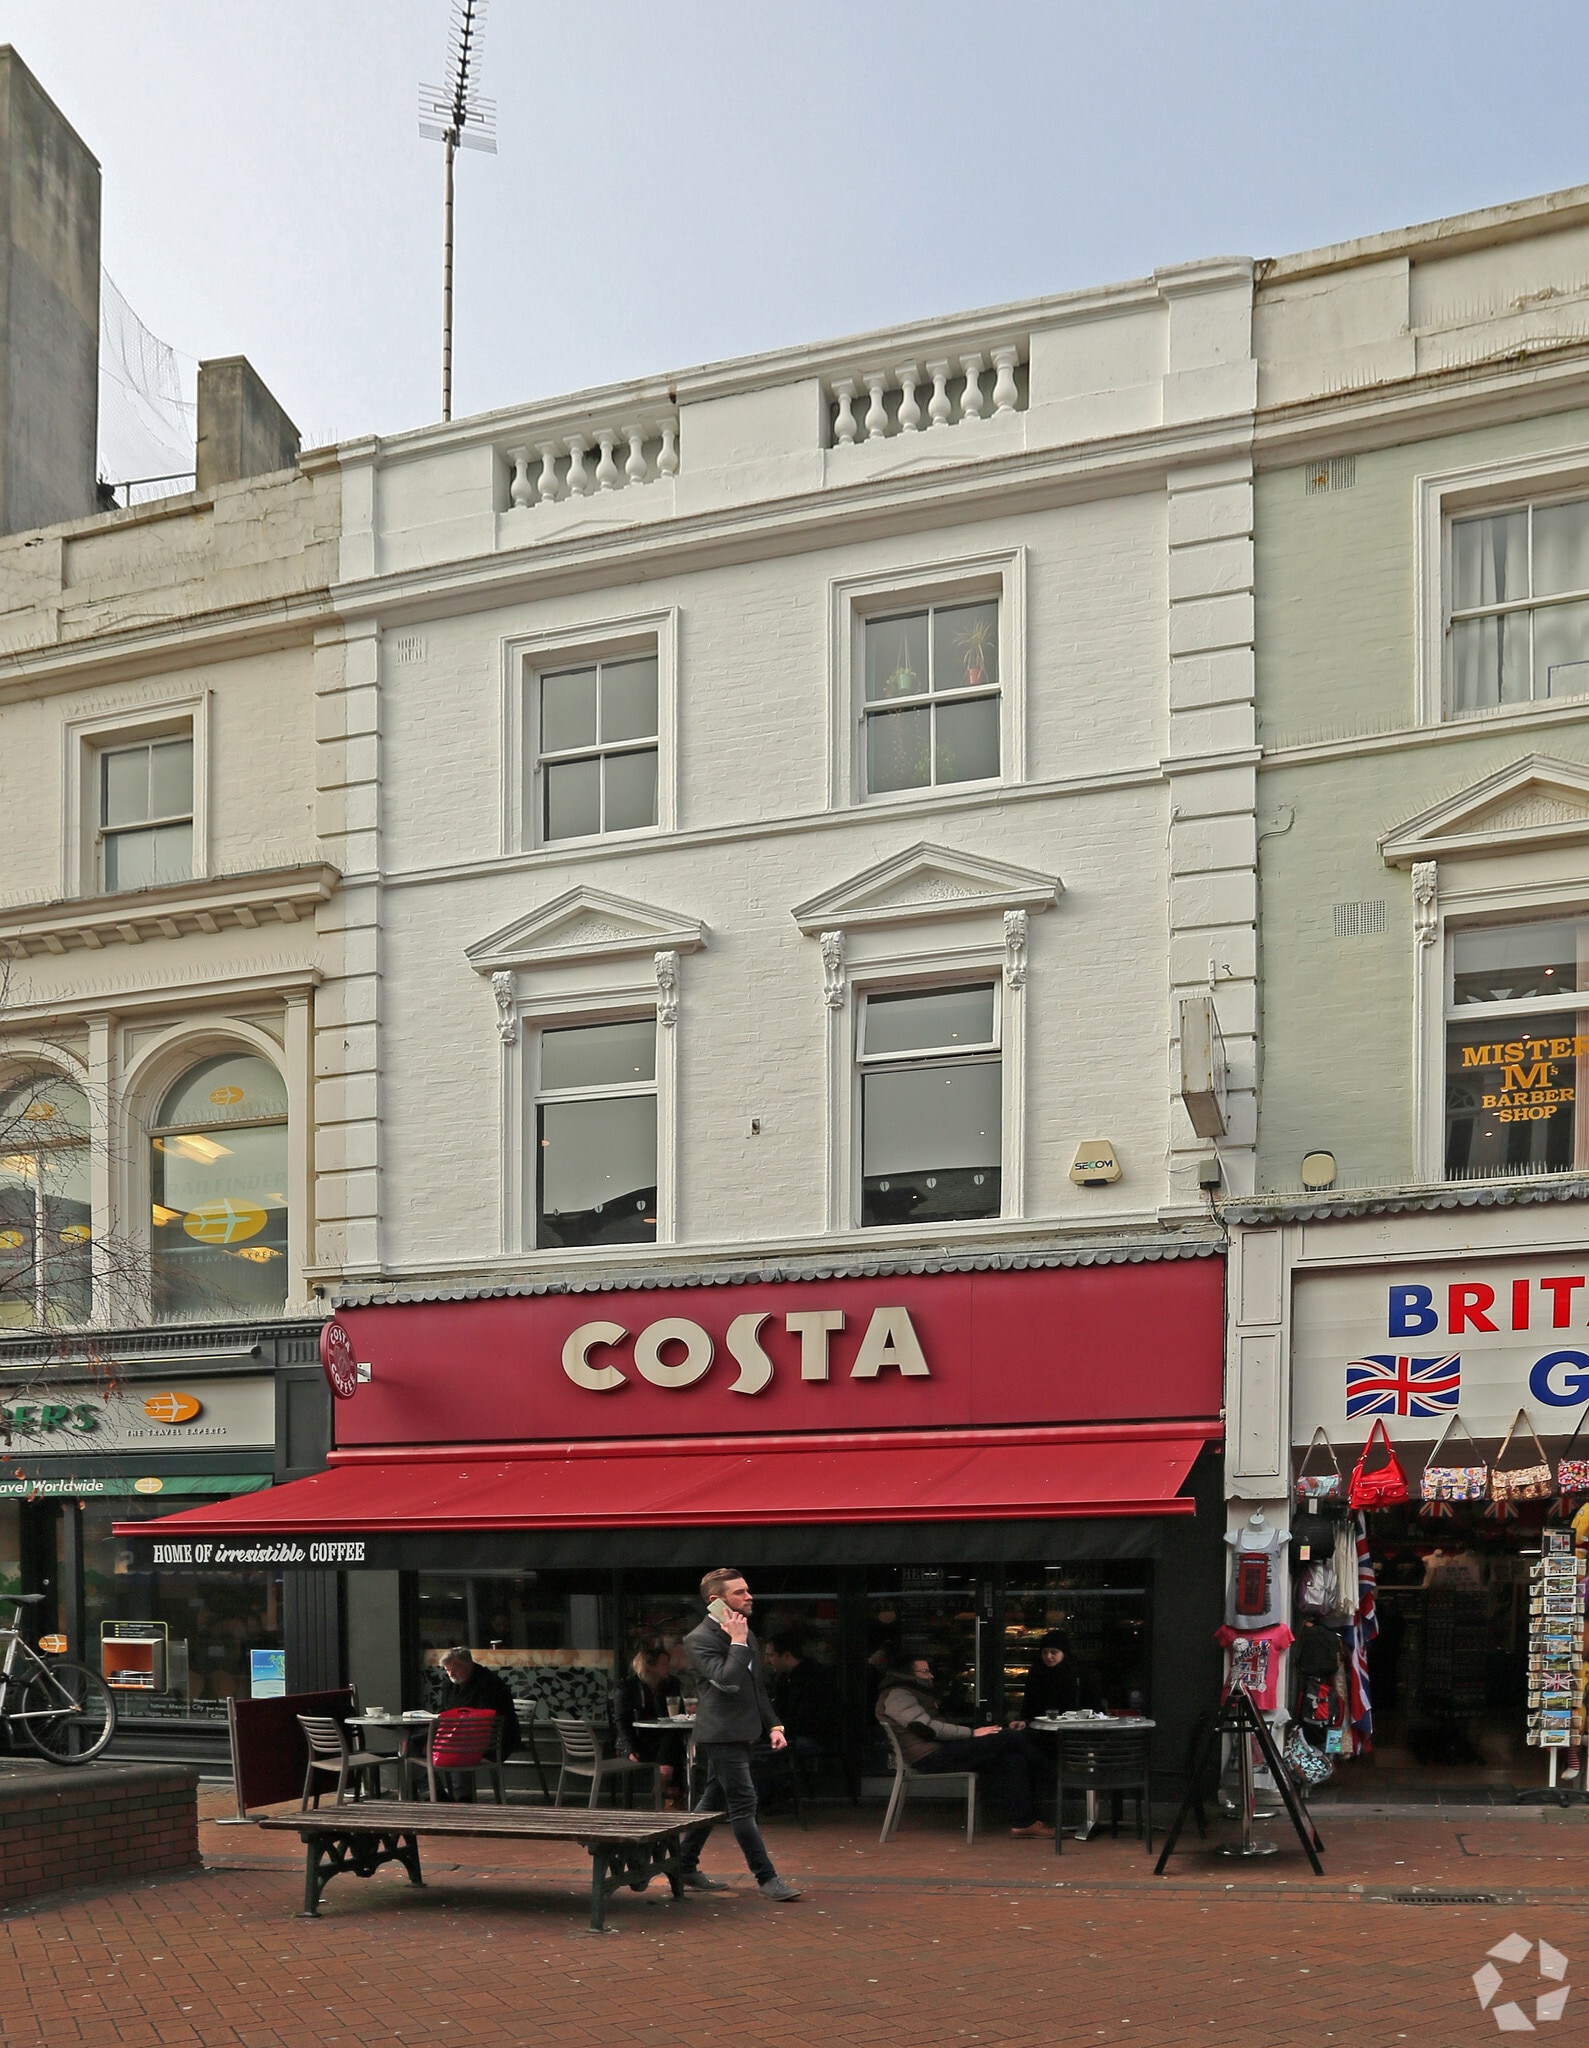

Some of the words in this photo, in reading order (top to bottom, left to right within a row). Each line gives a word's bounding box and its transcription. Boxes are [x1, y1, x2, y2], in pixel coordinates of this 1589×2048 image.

[1462, 1035, 1589, 1067] MISTER
[1482, 1088, 1576, 1109] BARBER
[1499, 1105, 1558, 1123] SHOP
[1074, 1159, 1113, 1171] SECOM
[1388, 1275, 1589, 1339] BRIT
[330, 1328, 351, 1353] COSTA
[561, 1306, 931, 1395] COSTA
[331, 1363, 356, 1394] COFFEE
[147, 1428, 182, 1436] TRAVEL
[186, 1427, 227, 1436] EXPERTS
[31, 1478, 104, 1492] Worldwide
[153, 1544, 193, 1563] HOME
[194, 1544, 213, 1563] OF
[215, 1542, 306, 1563] irresistible
[309, 1542, 365, 1562] COFFEE
